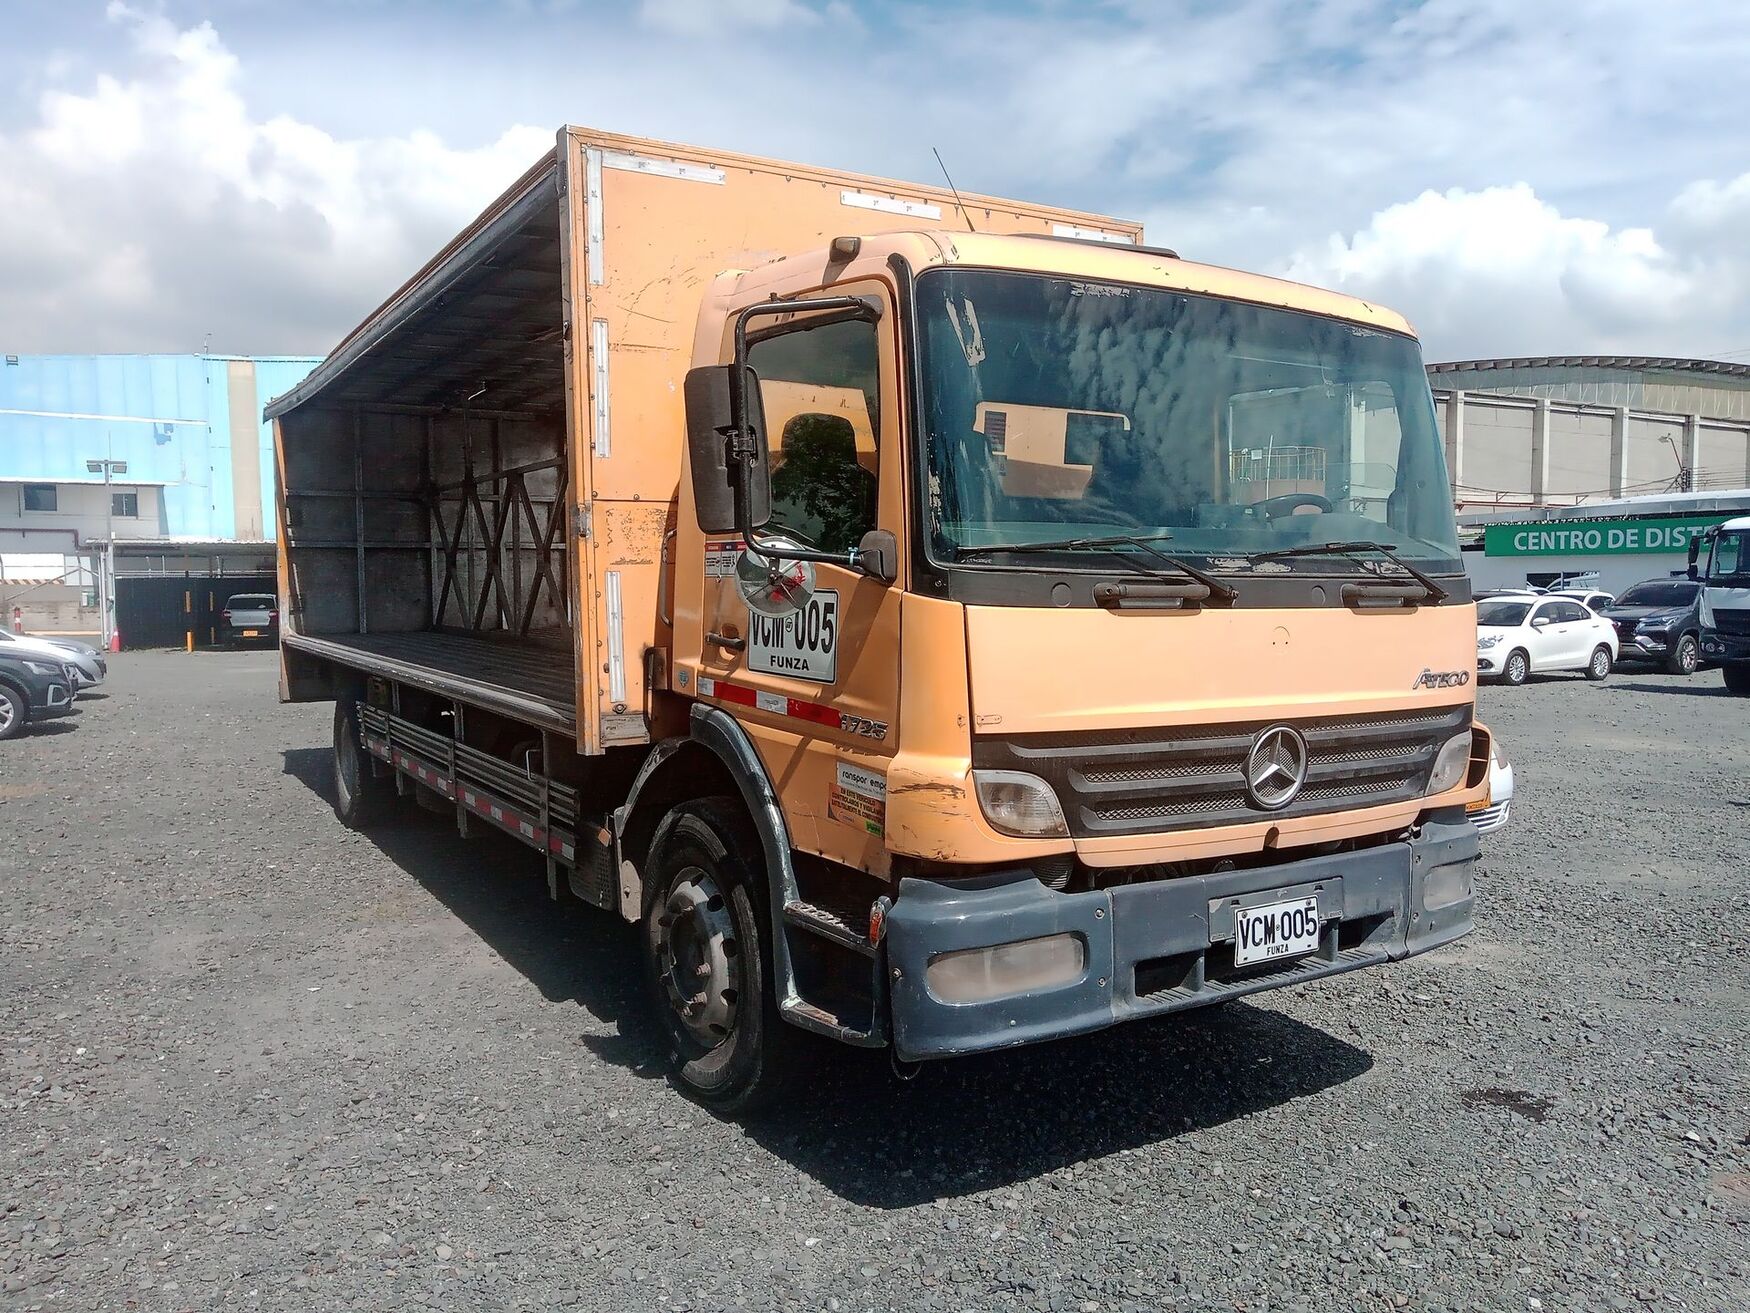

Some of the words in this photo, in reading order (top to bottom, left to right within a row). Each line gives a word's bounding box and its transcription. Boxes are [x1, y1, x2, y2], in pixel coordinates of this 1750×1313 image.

[1514, 529, 1601, 551] CENTRO
[1608, 528, 1639, 549] DE
[1646, 525, 1713, 547] DIST
[752, 611, 784, 648] VCM
[794, 599, 835, 654] 005
[770, 655, 810, 671] FUNZA
[841, 713, 888, 741] 1725
[1239, 913, 1276, 950] VCM
[1280, 906, 1318, 942] 005
[1266, 944, 1289, 956] FUNZA
